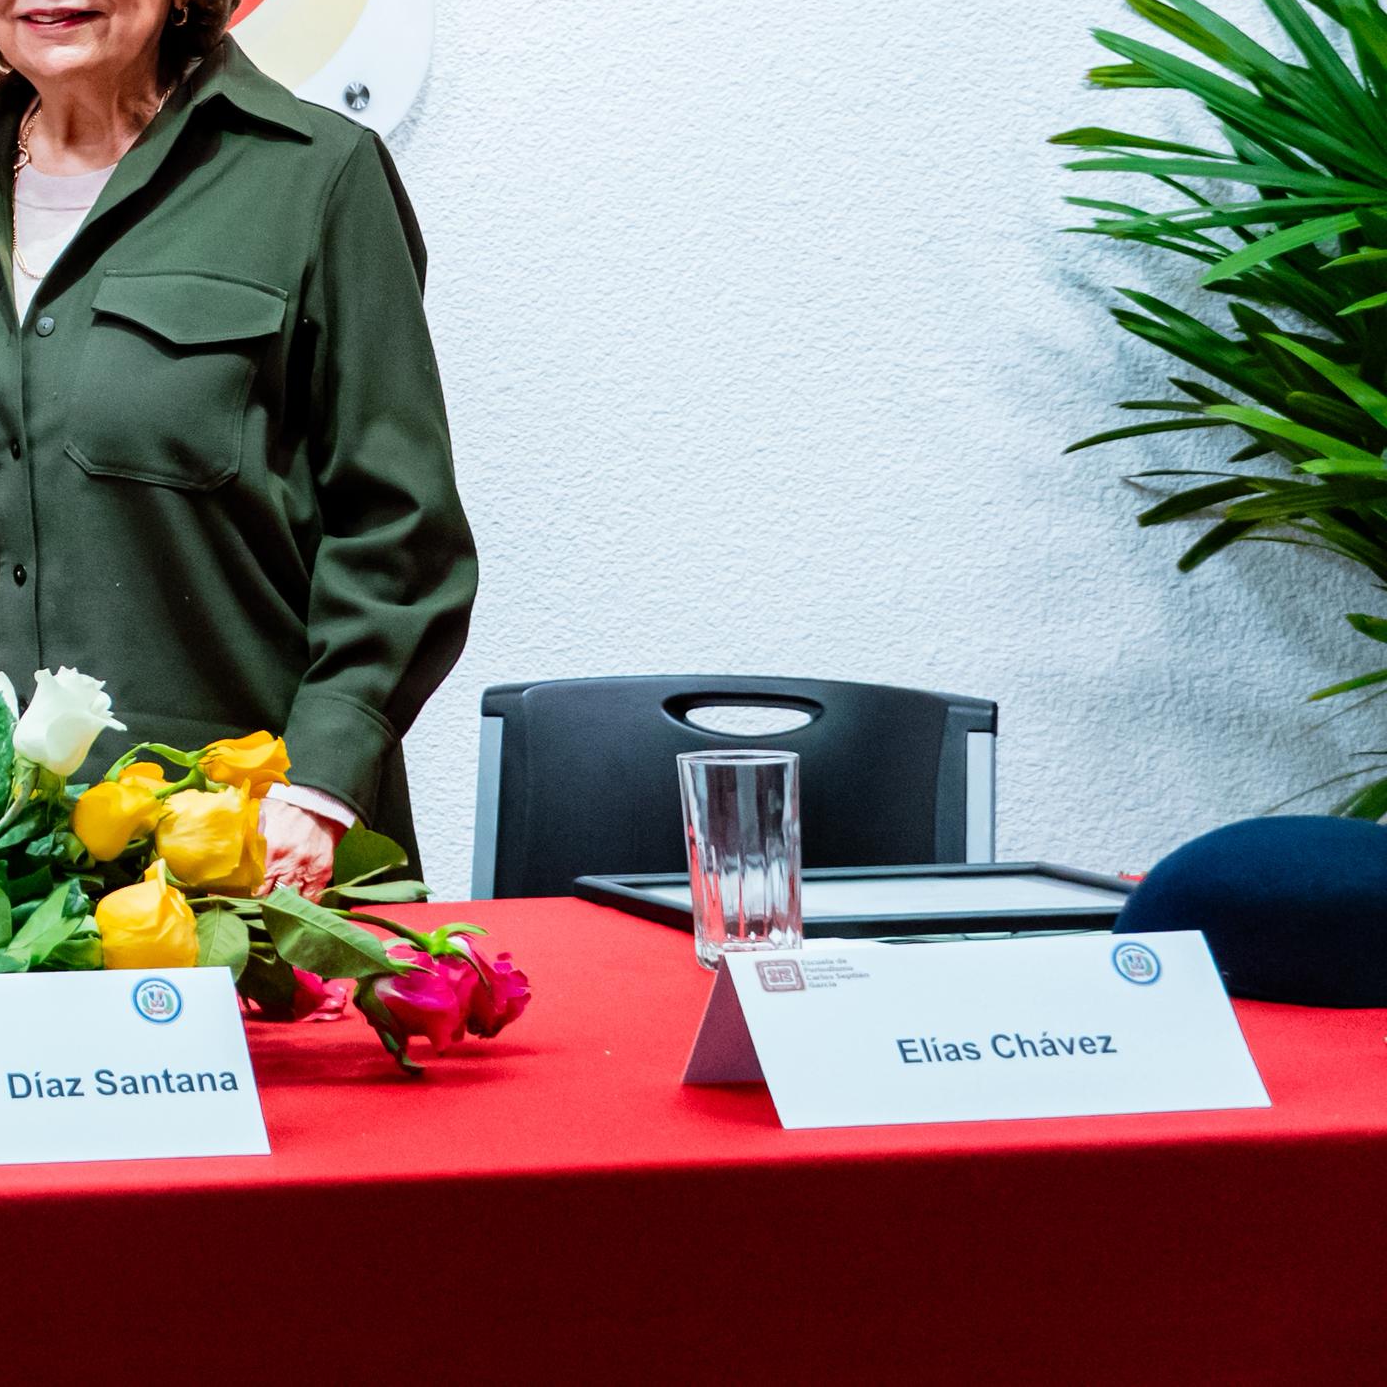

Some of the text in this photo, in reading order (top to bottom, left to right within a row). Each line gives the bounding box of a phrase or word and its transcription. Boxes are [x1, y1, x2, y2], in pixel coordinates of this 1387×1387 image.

[895, 1031, 1118, 1064] Elías Chávez
[6, 1071, 86, 1100] Díaz
[95, 1068, 240, 1097] Santana
